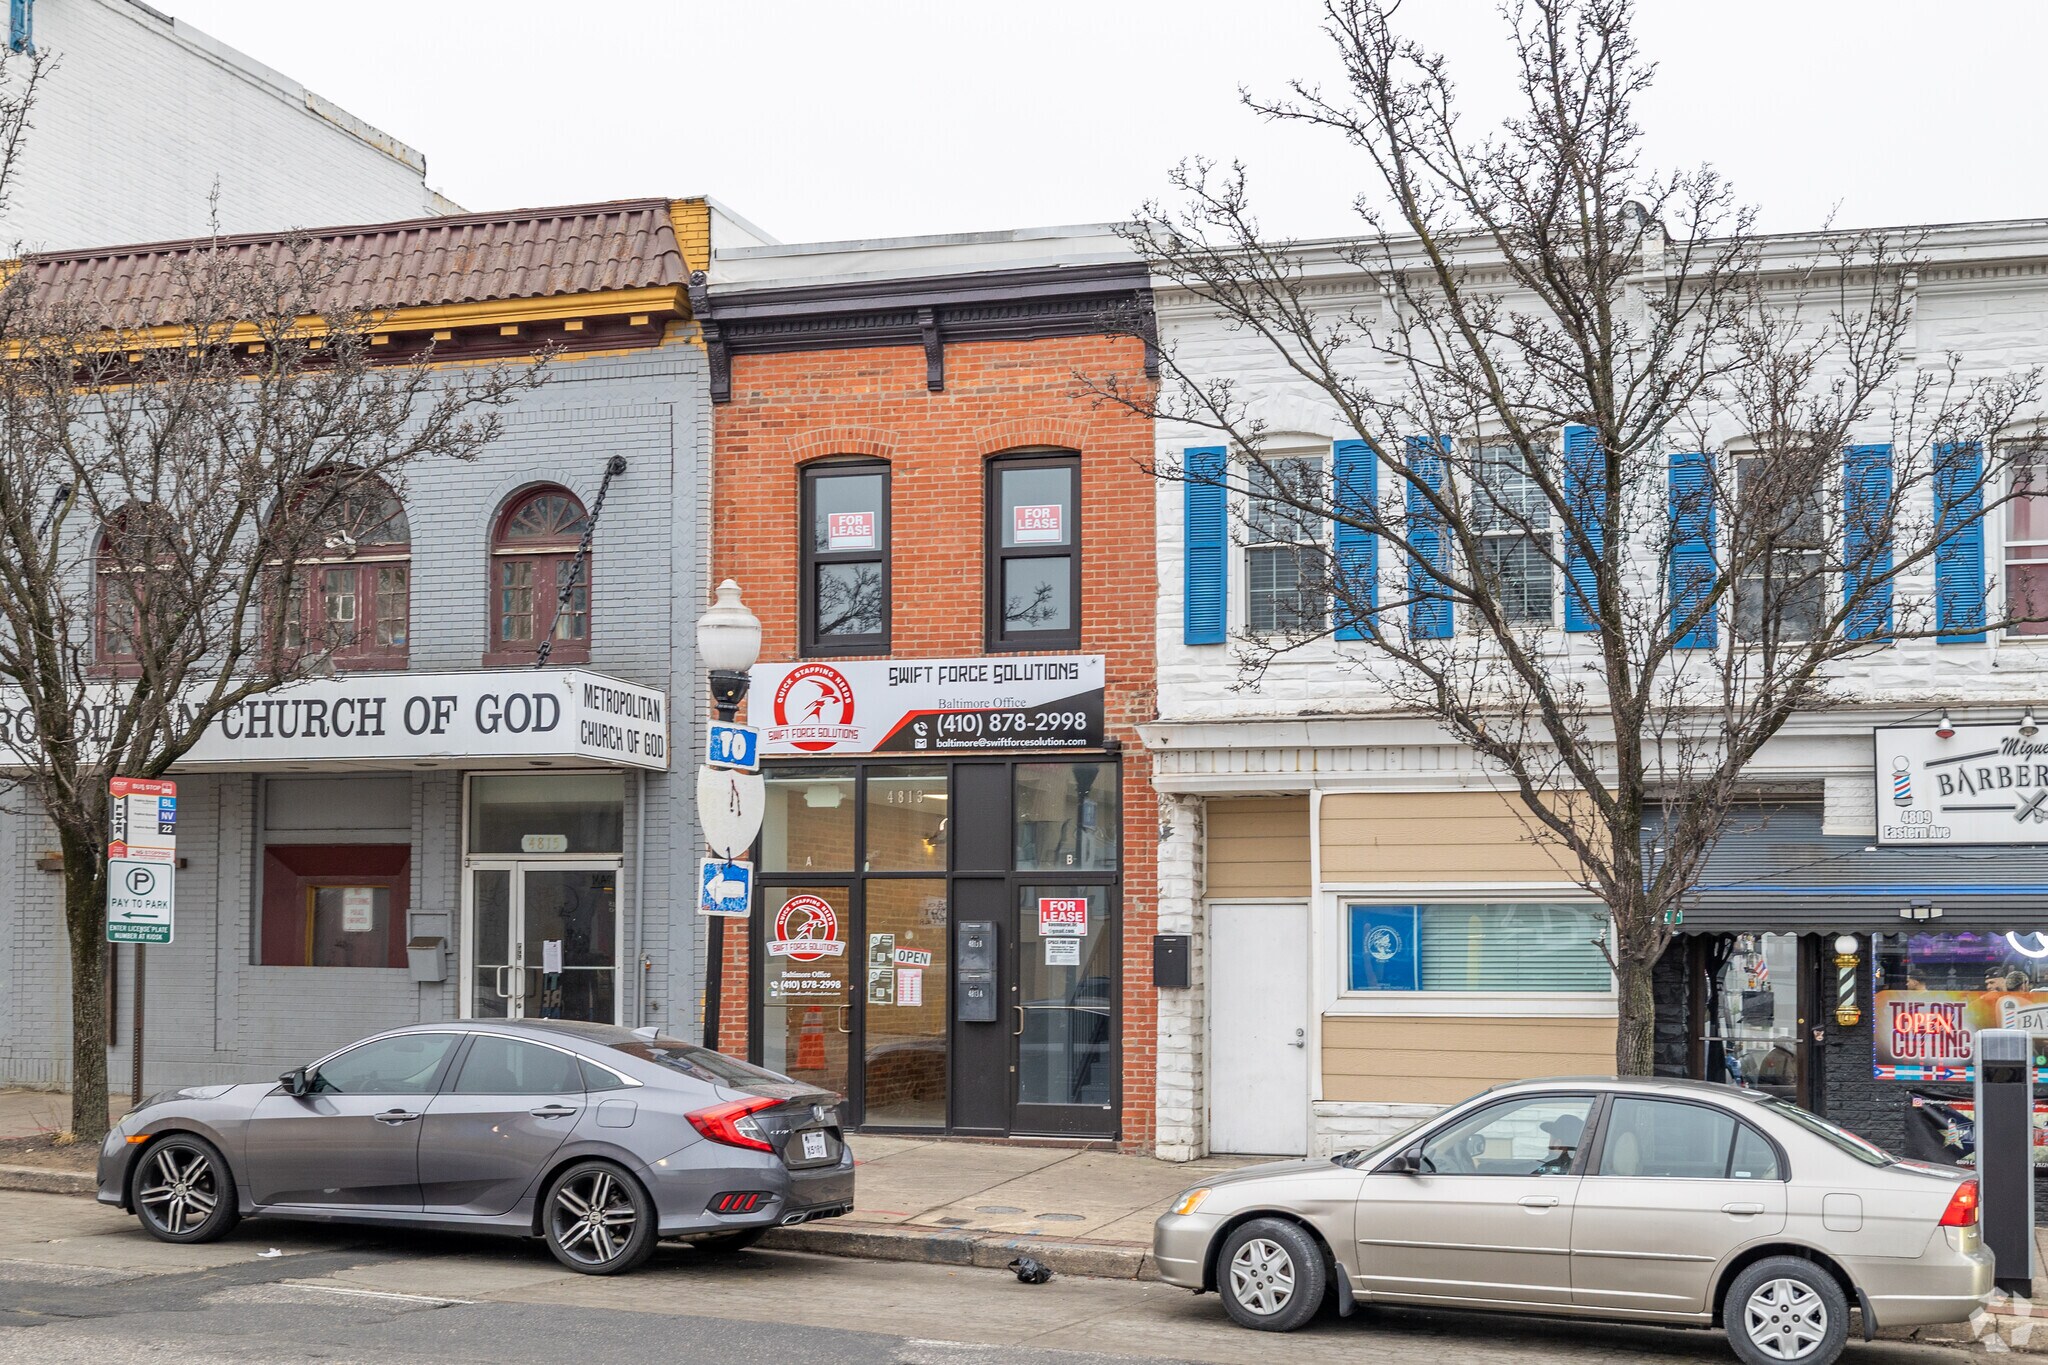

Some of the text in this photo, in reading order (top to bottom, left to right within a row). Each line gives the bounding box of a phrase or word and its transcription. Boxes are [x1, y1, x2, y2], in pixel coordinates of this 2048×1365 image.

[1024, 508, 1051, 519] FOR
[838, 515, 864, 526] FOR
[1017, 518, 1058, 530] LEASE
[831, 525, 871, 537] LEASE
[888, 662, 1080, 687] SWIFT FORCE SOLUTIONS
[776, 666, 853, 704] QUICK STAFFING NEEDS
[583, 682, 661, 723] METROPOLITAN
[938, 696, 1027, 709] Baltimore Office
[221, 697, 387, 740] CHURCH
[403, 694, 458, 736] OF
[475, 692, 561, 734] GOD
[936, 711, 1088, 737] (410) 878-2998
[580, 719, 664, 759] CHURCH OF GOD
[767, 727, 859, 741] SWIFT FORCE SOLUTIONS
[719, 730, 747, 761] TO
[935, 736, 1087, 749] baltimore@swiftforcesolution.com
[161, 798, 174, 808] BL
[887, 789, 923, 804] 4813
[160, 811, 174, 821] NV
[1901, 810, 1933, 825] 4809
[161, 824, 173, 834] 22
[1883, 825, 1951, 839] Eastern Ave
[528, 836, 561, 850] 4815
[805, 855, 813, 867] A
[1066, 854, 1073, 865] B
[134, 872, 150, 891] P
[111, 898, 168, 910] PAY TO PARK
[1049, 901, 1076, 912] FOR
[1042, 911, 1084, 923] LEASE
[109, 924, 127, 932] ENTER
[897, 950, 929, 965] OPEN
[781, 970, 832, 978] Baltimore Office
[780, 980, 842, 990] (410) 878-2998
[1895, 1012, 1953, 1034] OPEN
